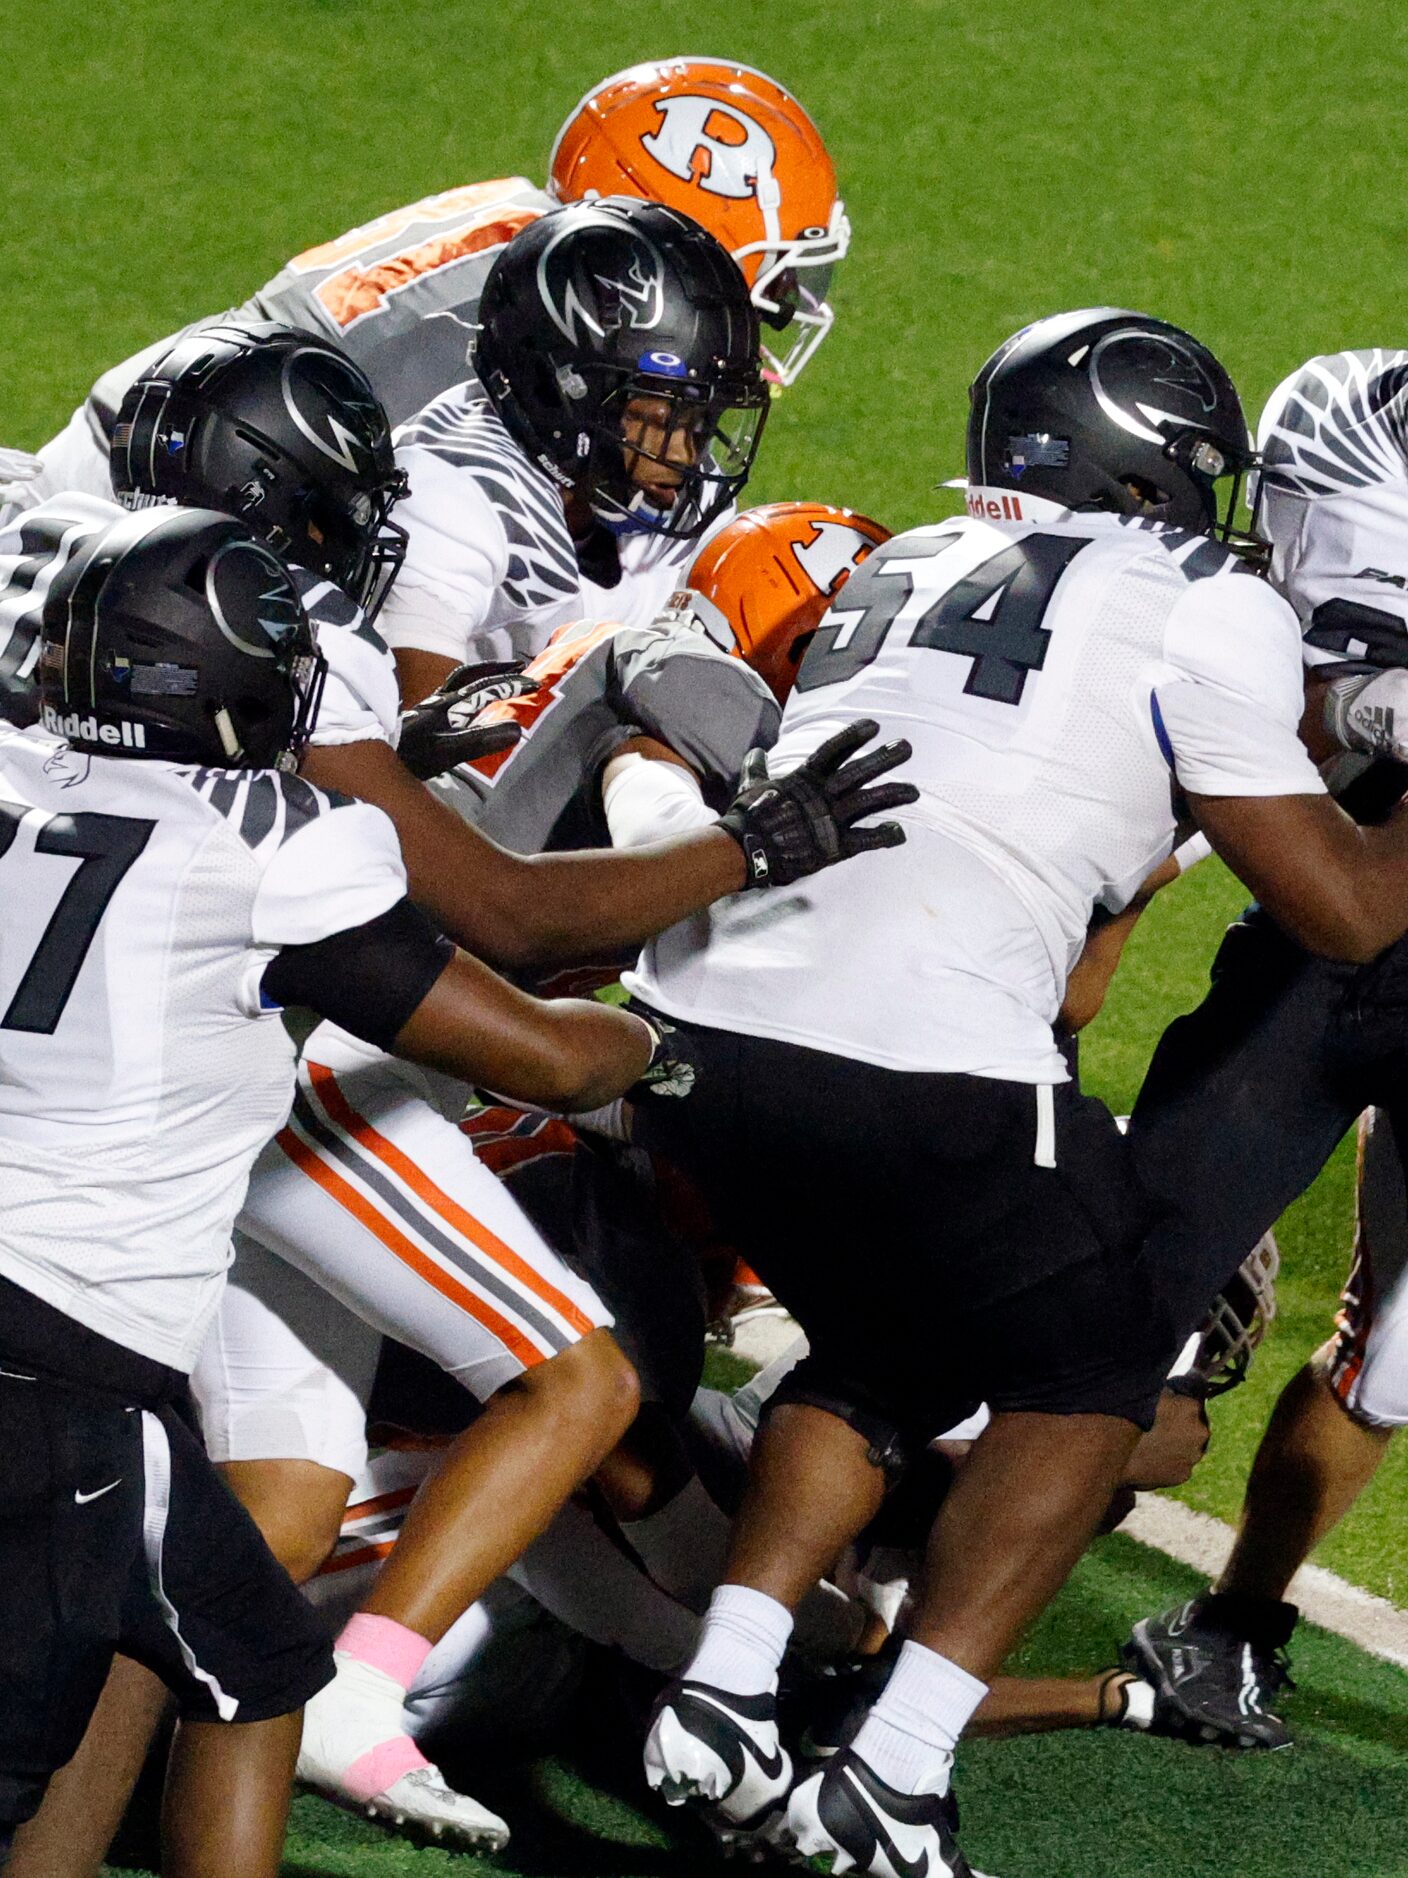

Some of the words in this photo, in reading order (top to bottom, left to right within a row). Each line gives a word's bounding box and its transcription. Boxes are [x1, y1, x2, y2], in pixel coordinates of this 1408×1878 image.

[640, 94, 777, 199] R
[795, 531, 1097, 706] 54
[43, 704, 147, 749] Riddell
